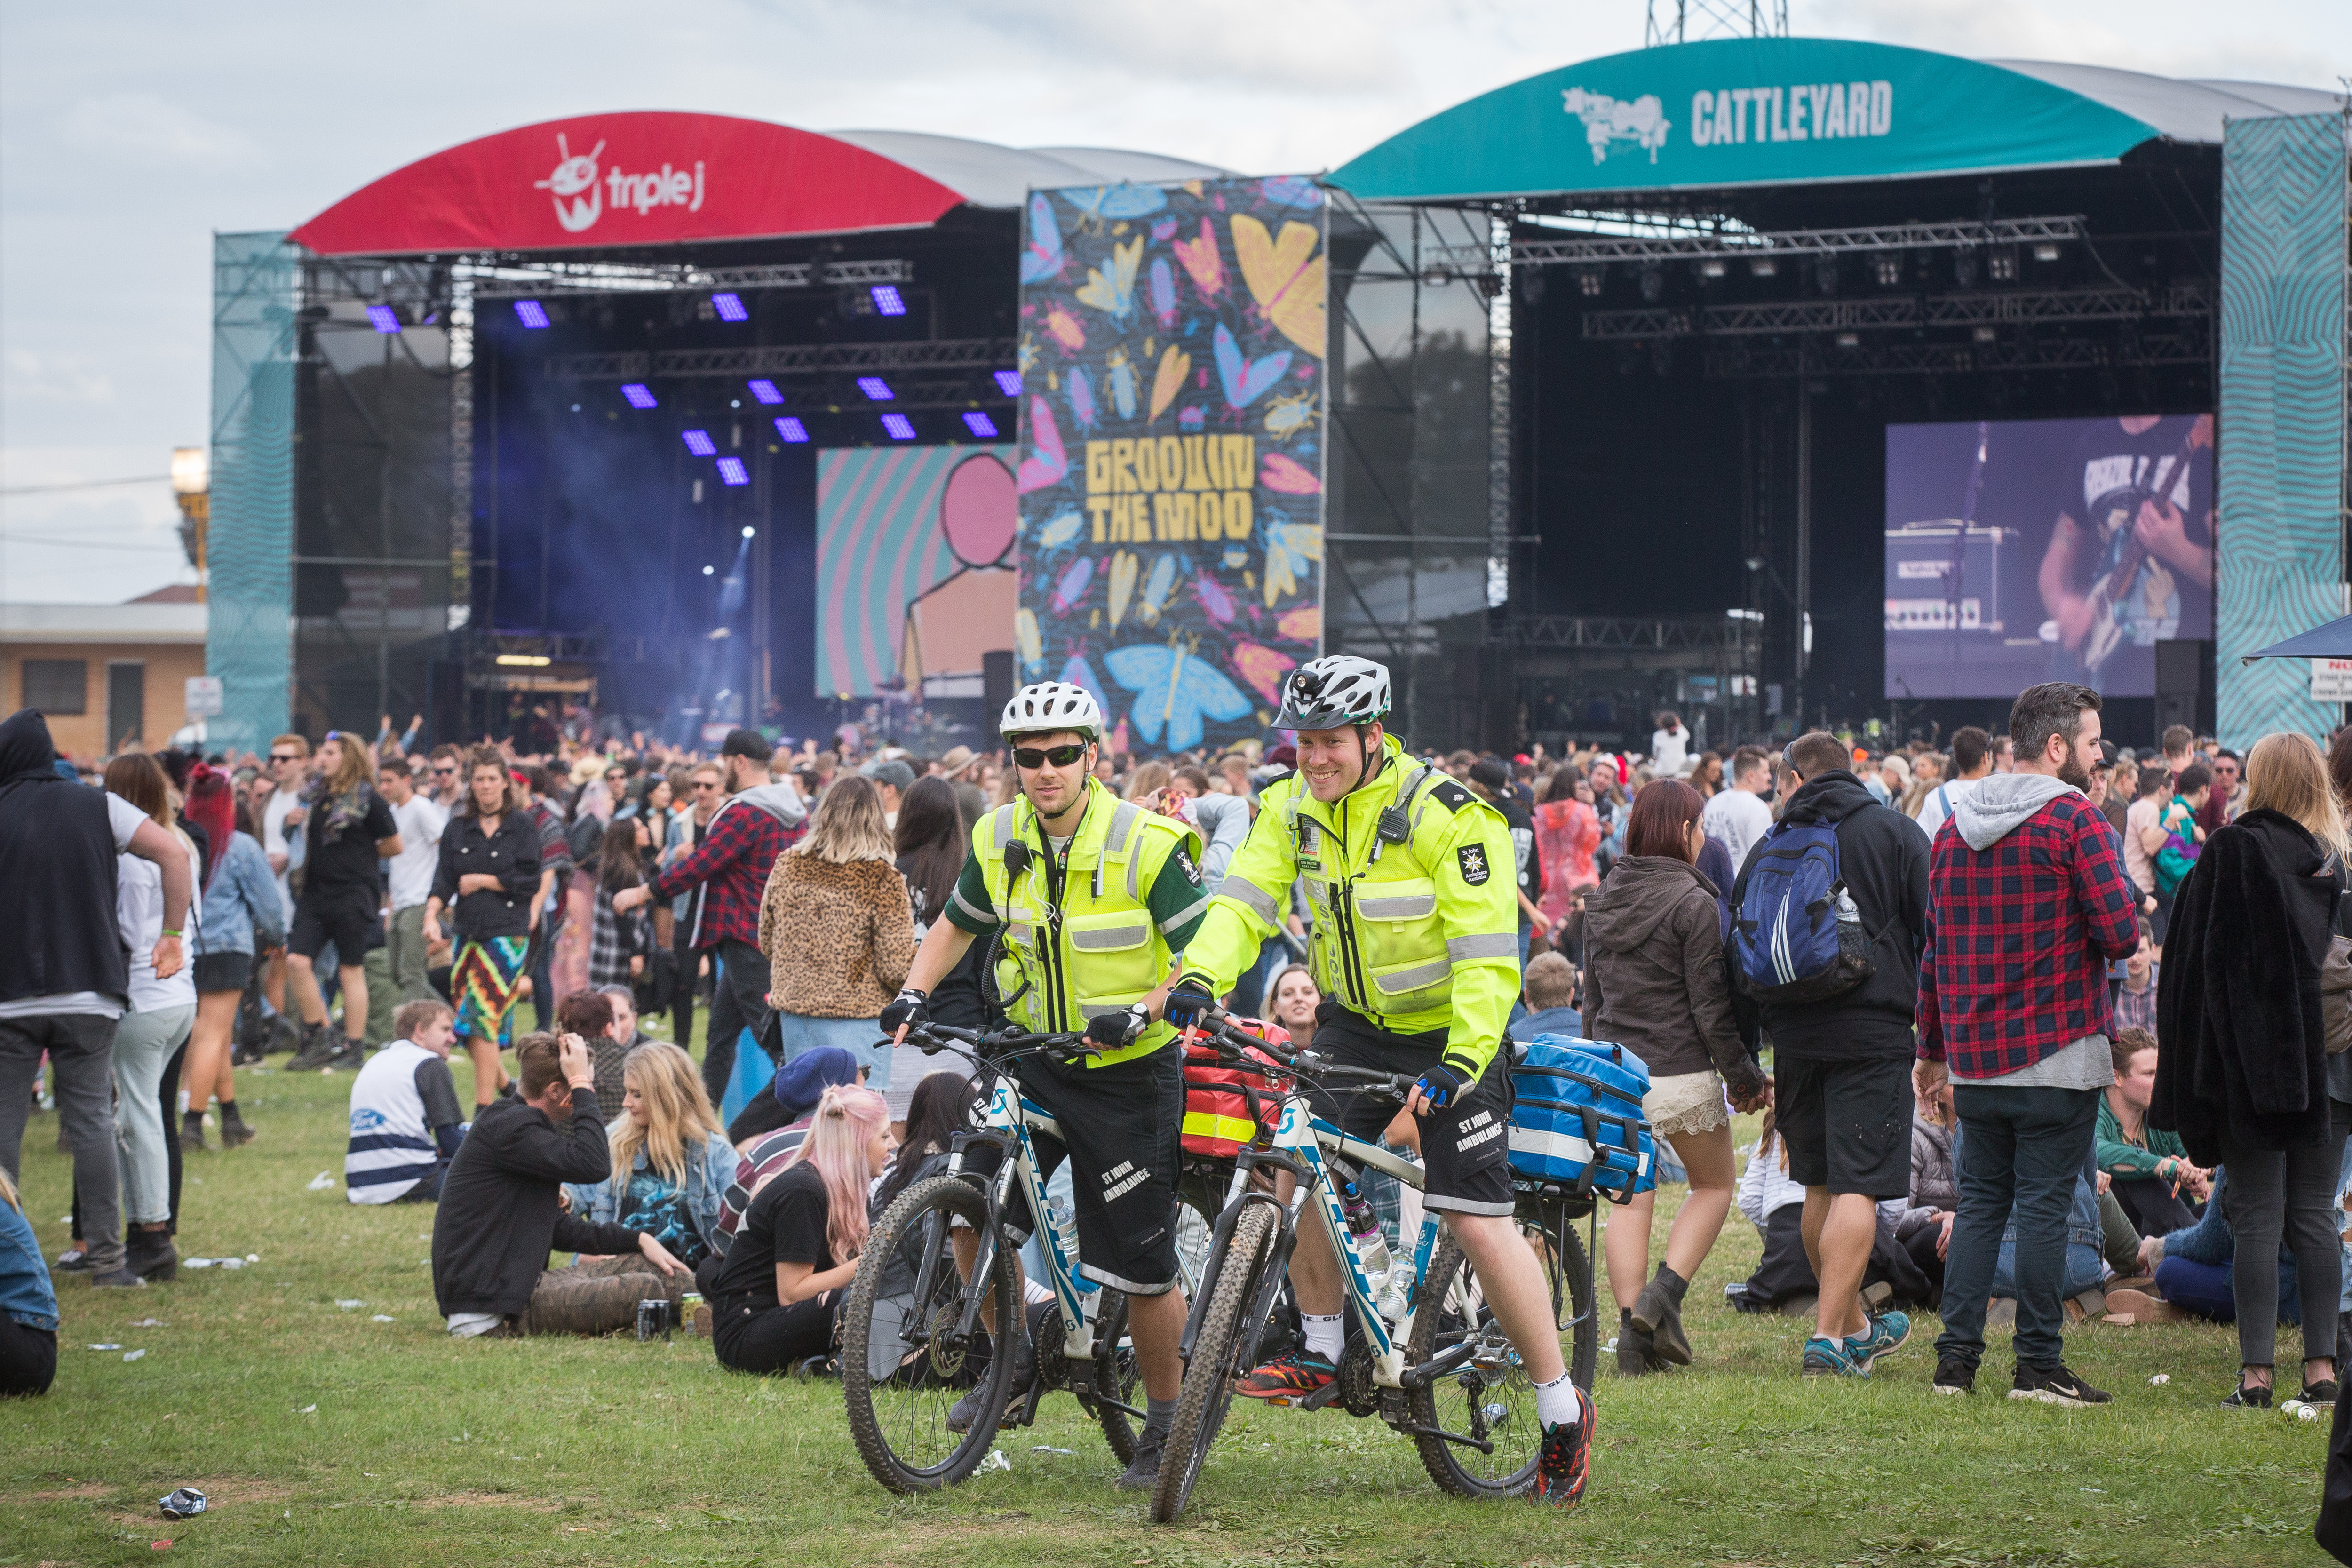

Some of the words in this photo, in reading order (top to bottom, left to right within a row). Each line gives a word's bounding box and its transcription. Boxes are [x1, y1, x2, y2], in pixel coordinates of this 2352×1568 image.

[1691, 80, 1892, 147] CATTLEYARD
[1087, 493, 1152, 543] THE
[1153, 491, 1253, 541] MOO
[1319, 905, 1332, 934] ST
[1020, 946, 1035, 971] ST
[973, 1098, 985, 1109] ST
[1458, 1119, 1472, 1133] ST
[1471, 1110, 1492, 1128] JOHN
[1456, 1122, 1503, 1152] AMBULANCE
[1477, 1148, 1500, 1161] ENDURA
[1101, 1172, 1113, 1185] ST
[1110, 1160, 1134, 1180] JOHN
[1103, 1168, 1151, 1202] AMBULANCE
